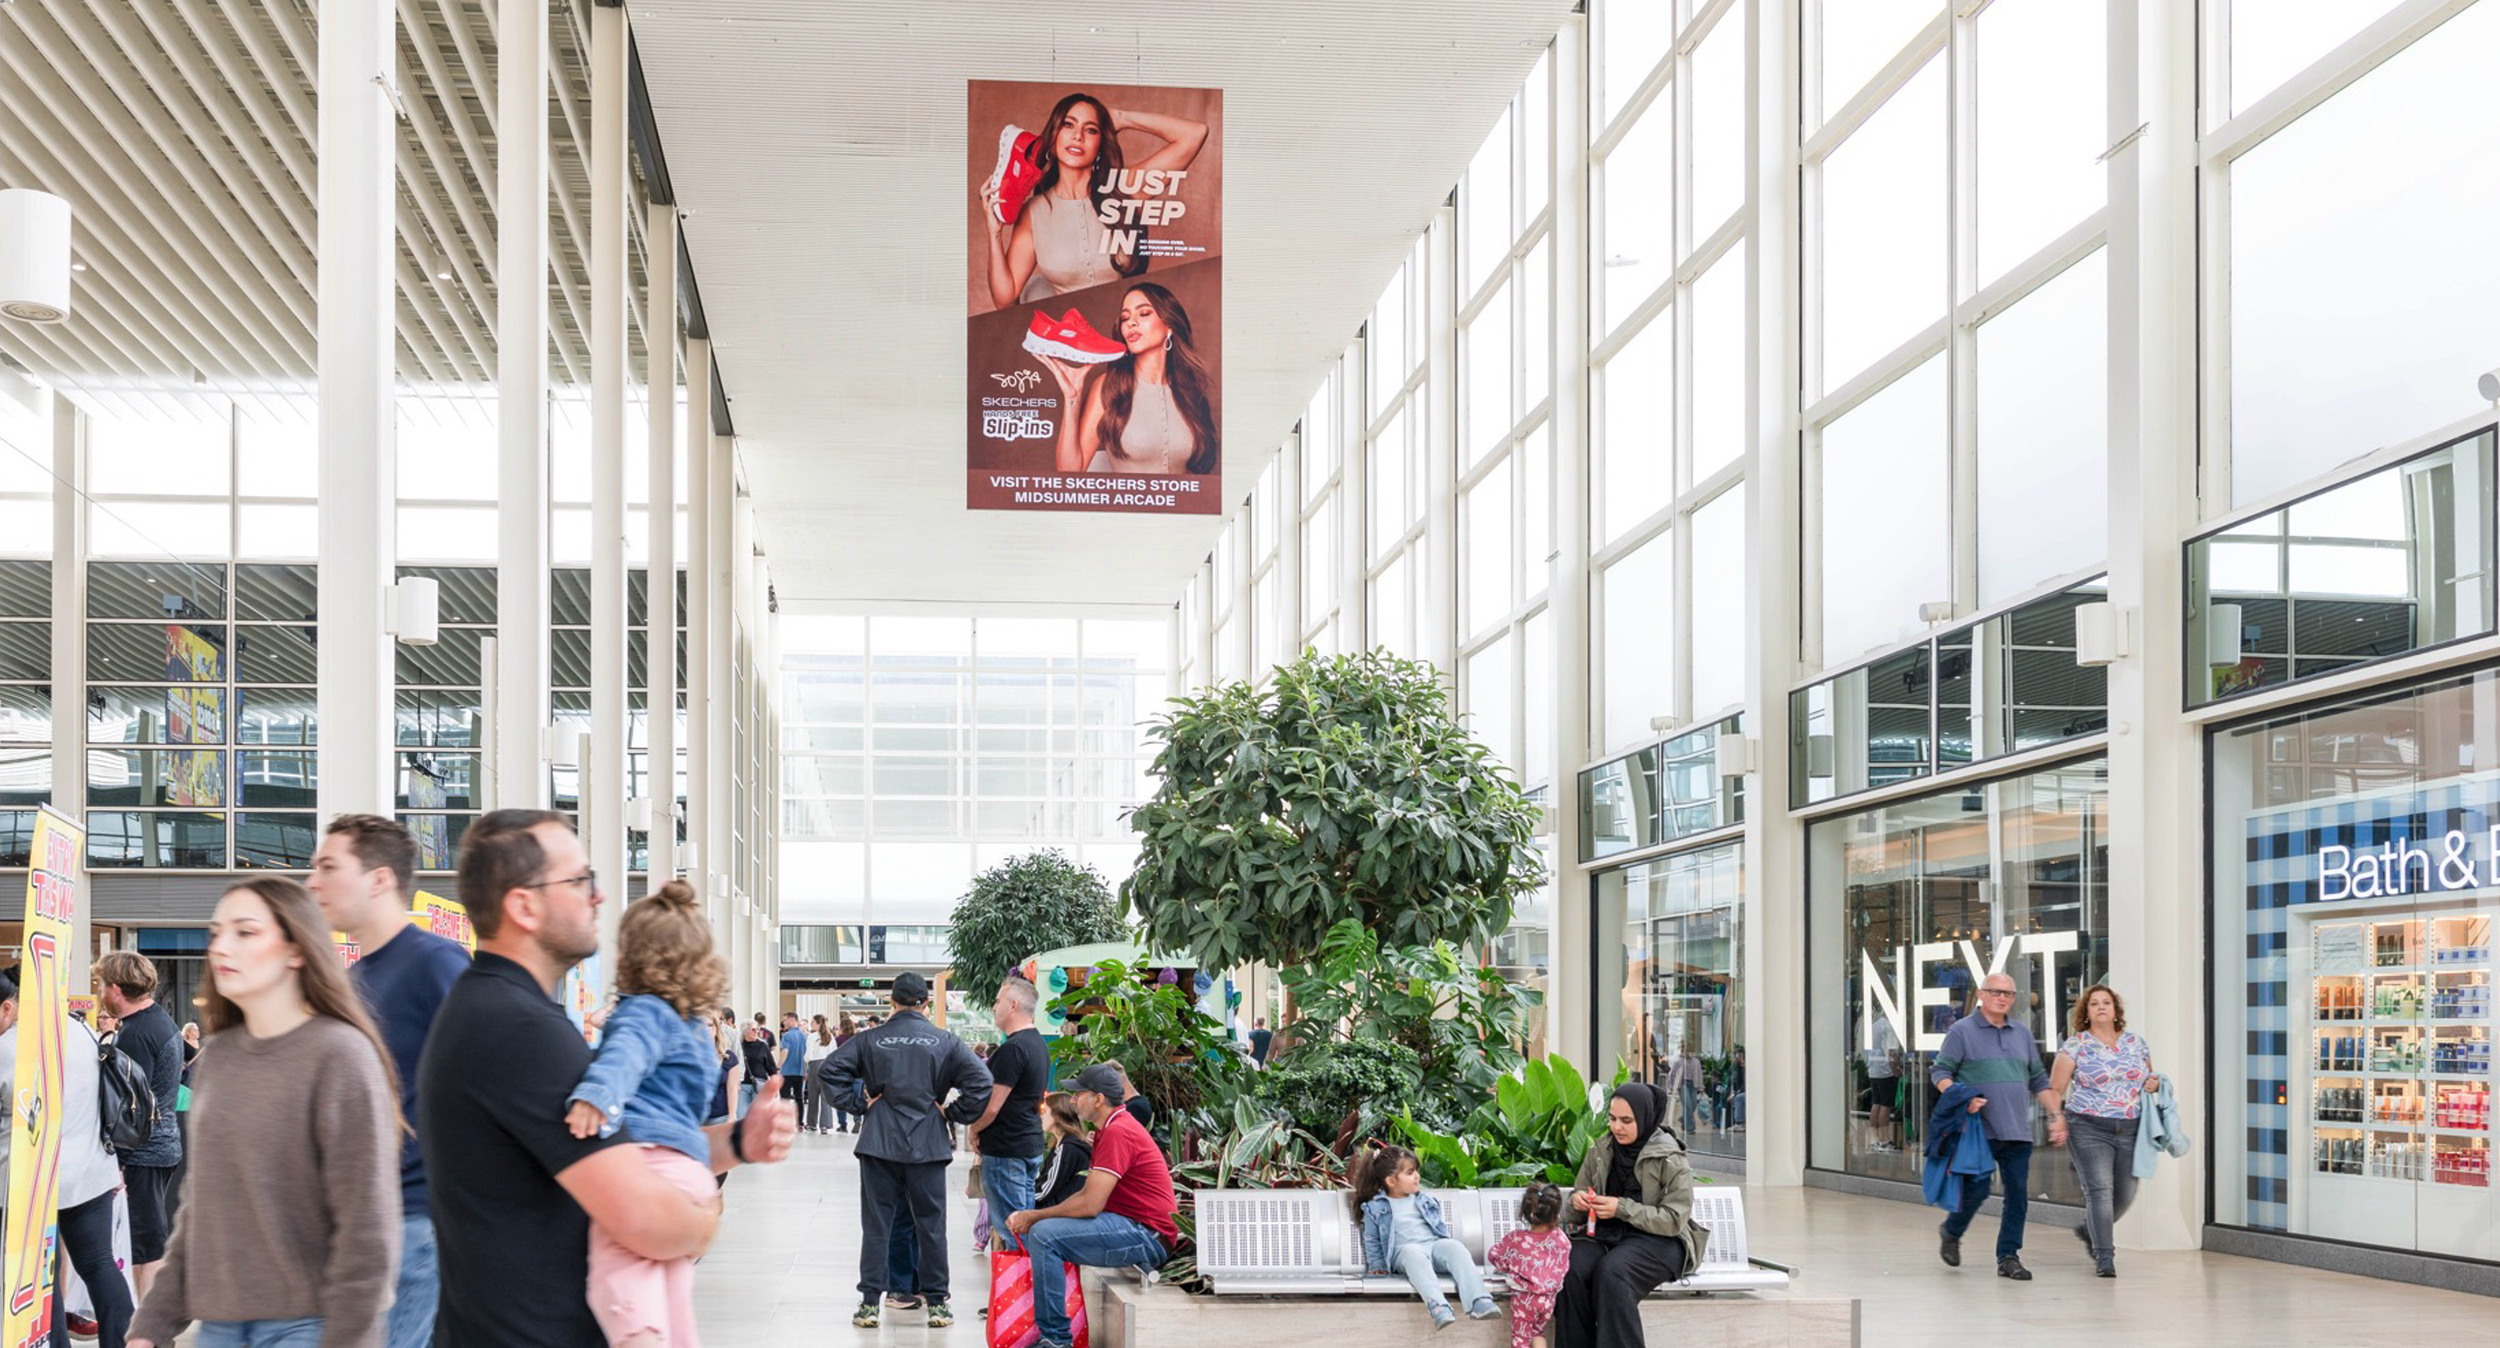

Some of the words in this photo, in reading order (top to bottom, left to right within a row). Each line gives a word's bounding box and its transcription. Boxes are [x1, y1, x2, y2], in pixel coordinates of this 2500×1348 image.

[1097, 168, 1187, 196] JUST
[1098, 198, 1186, 226] STEP
[982, 397, 1057, 408] SKECHERS
[985, 418, 1053, 439] Slip-ins
[990, 476, 1030, 488] VISIT
[1032, 477, 1063, 489] THE
[1065, 478, 1147, 491] SKECHERS
[1149, 480, 1200, 492] STORE
[1015, 491, 1111, 505] MIDSUMMER
[1113, 494, 1176, 507] ARCADE
[2319, 836, 2430, 901] Bath
[2438, 829, 2480, 890] &
[1863, 930, 2078, 1053] NEXT
[880, 1036, 936, 1046] SPURS
